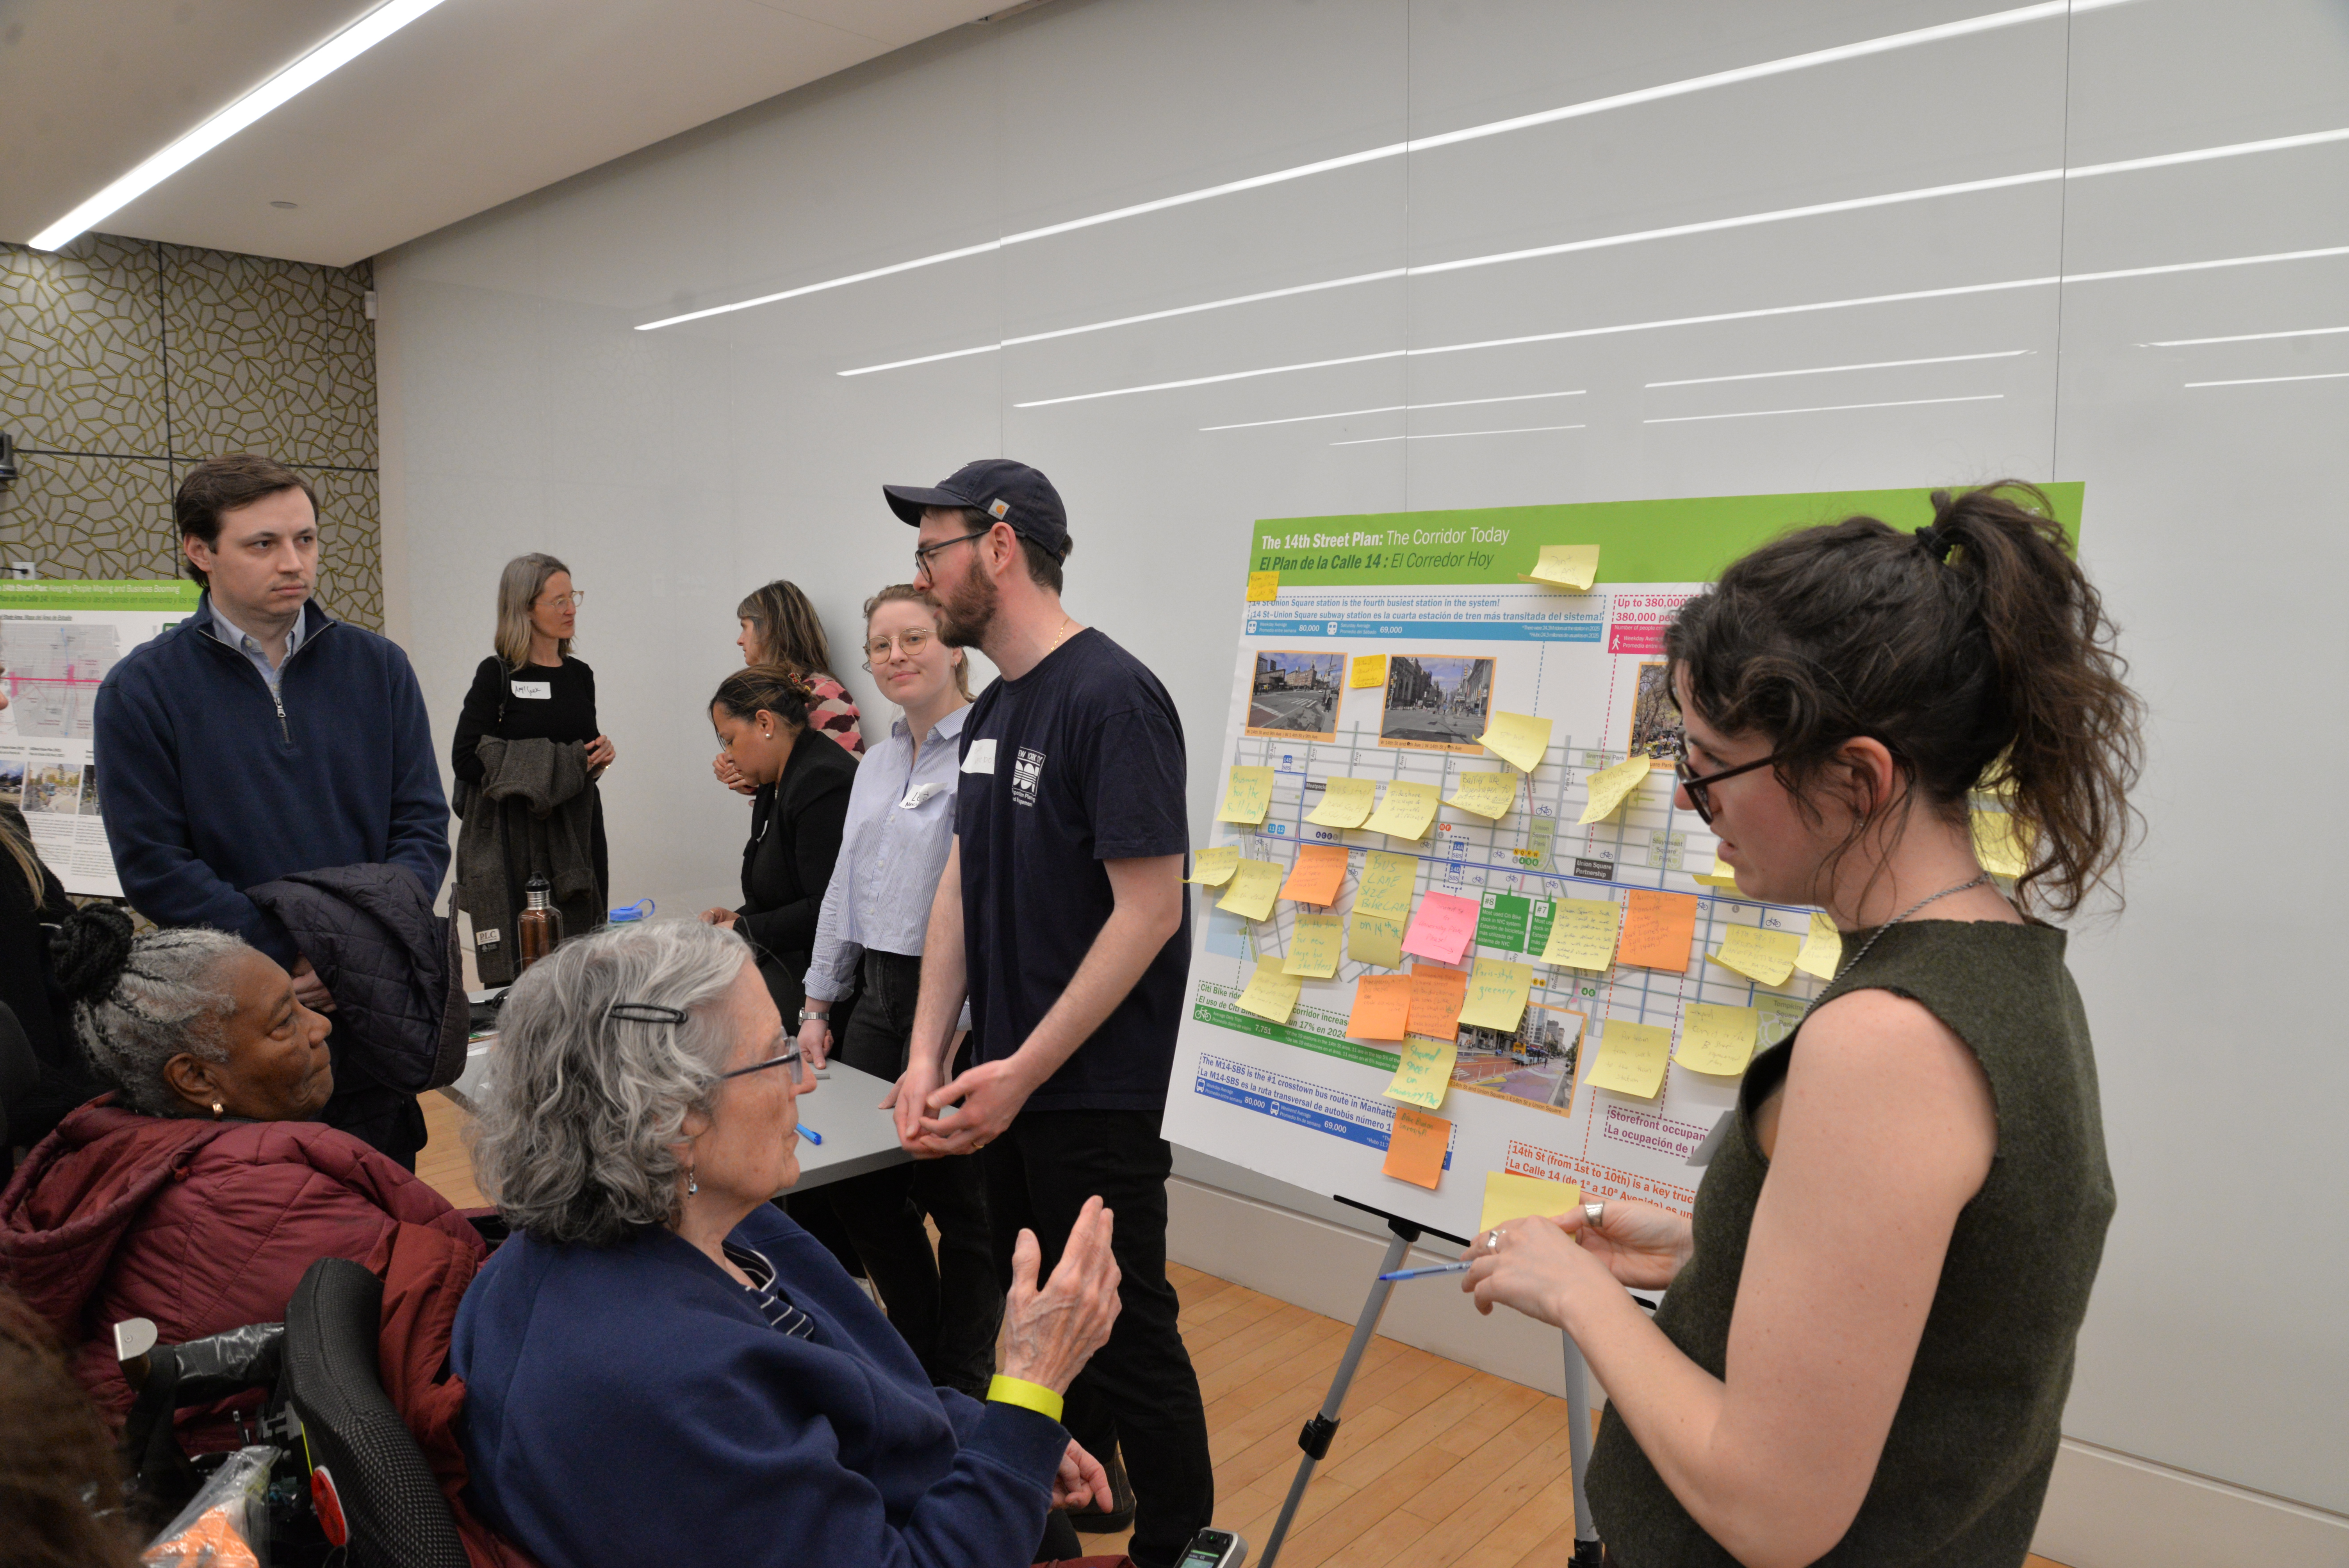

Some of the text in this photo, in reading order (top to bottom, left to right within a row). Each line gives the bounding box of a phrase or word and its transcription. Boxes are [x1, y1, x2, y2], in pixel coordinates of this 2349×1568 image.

[1262, 526, 1510, 550] The 14th Street Plan: The Corridor Today
[1259, 557, 1271, 571] El
[1272, 556, 1297, 570] Plan
[1300, 556, 1314, 570] de
[1317, 556, 1328, 570] la
[1331, 554, 1362, 569] Calle
[1365, 553, 1381, 568] 14
[1391, 553, 1404, 568] El
[1406, 552, 1465, 568] Corredor
[1467, 551, 1495, 570] Hoy
[1291, 599, 1314, 608] Square
[1469, 599, 1500, 608] system!
[1618, 598, 1686, 609] Up to 380,000
[1294, 611, 1317, 620] Square
[1319, 611, 1345, 620] subway
[1419, 611, 1451, 620] estación
[1484, 611, 1501, 620] más
[1503, 612, 1546, 620] transitada
[1548, 612, 1561, 621] del
[1563, 613, 1602, 621] sistema!
[1616, 613, 1656, 623] 380,000
[1592, 862, 1612, 871] Square
[1576, 868, 1606, 878] Partnership
[1485, 897, 1495, 905] #8
[1489, 931, 1506, 939] utilizada
[1504, 926, 1524, 935] bicicletas
[1201, 984, 1211, 993] Citi
[1213, 987, 1227, 996] Bike
[1292, 1007, 1320, 1019] corridor
[1321, 1012, 1349, 1026] increas
[1773, 1000, 1804, 1011] Tompkins
[1206, 998, 1217, 1006] uso
[1219, 1001, 1227, 1009] de
[1228, 1003, 1239, 1012] Citi
[1299, 1021, 1315, 1031] 17%
[1316, 1026, 1326, 1034] en
[1327, 1027, 1347, 1039] 2024
[1776, 1010, 1798, 1019] Square
[1778, 1019, 1793, 1028] Park
[1255, 1024, 1271, 1035] 7,751
[1202, 1056, 1396, 1119] The M14-SBS is the #1 crosstown bus route in Manhatta
[1200, 1068, 1392, 1131] La M14-SBS es la ruta transversal de autobús número 1
[1244, 1096, 1265, 1108] 80,000
[1324, 1120, 1347, 1133] 69,000
[1610, 1109, 1706, 1141] Storefront occupan
[1608, 1124, 1688, 1154] La ocupación de
[1510, 1159, 1520, 1170] La
[1523, 1163, 1545, 1177] Calle
[1547, 1170, 1560, 1181] 14
[1562, 1174, 1577, 1185] (de
[1592, 1185, 1598, 1193] a
[1512, 1145, 1533, 1158] 14th
[1535, 1151, 1545, 1162] St
[1547, 1155, 1572, 1170] (from
[1574, 1162, 1590, 1175] 1st
[1592, 1167, 1602, 1178] to
[1604, 1171, 1631, 1188] 10th)
[1633, 1178, 1641, 1189] is
[1652, 1184, 1670, 1199] key
